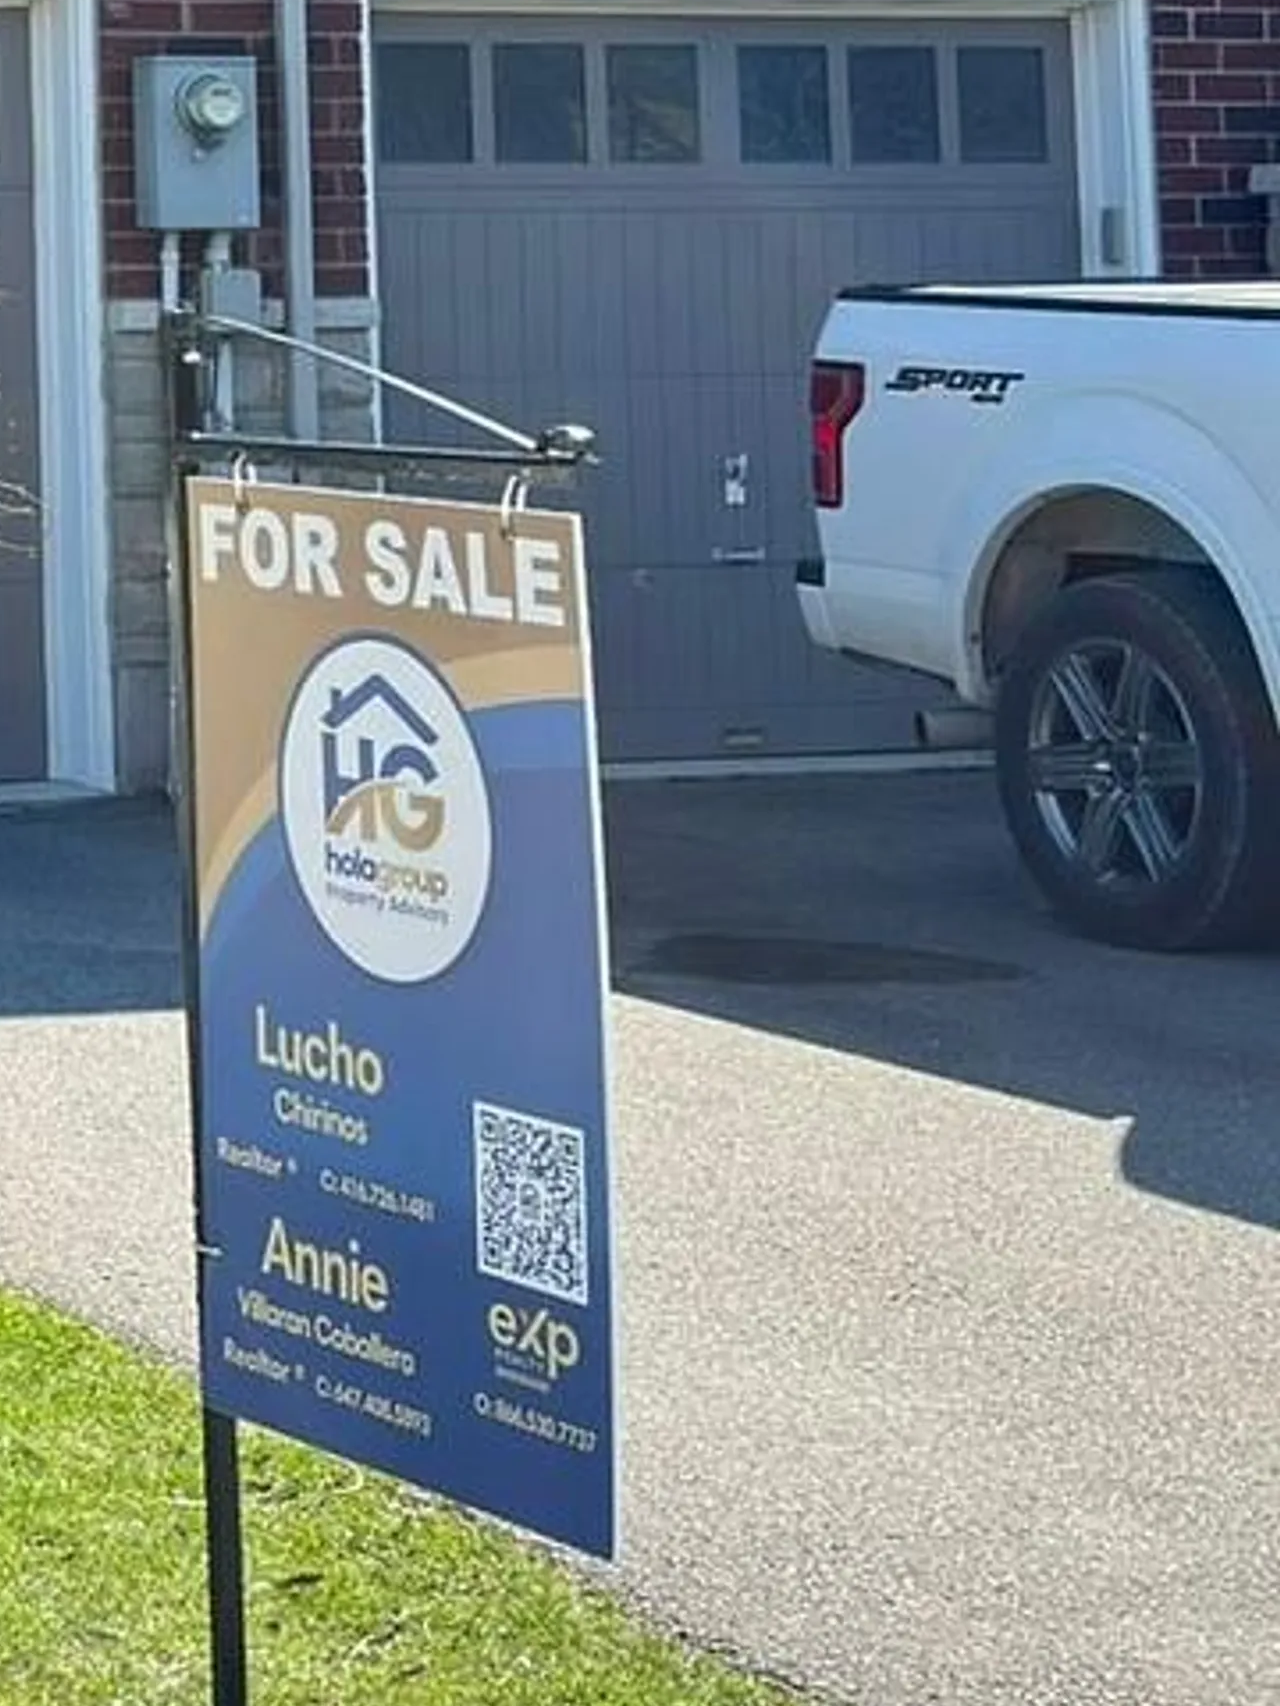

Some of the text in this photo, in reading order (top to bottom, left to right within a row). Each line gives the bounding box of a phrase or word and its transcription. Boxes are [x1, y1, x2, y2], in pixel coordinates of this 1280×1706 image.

[885, 366, 1025, 392] SPORT
[198, 502, 565, 627] FOR SALE
[255, 1003, 383, 1095] Lucho
[273, 1087, 368, 1146] Chirinos
[260, 1215, 390, 1314] Annie
